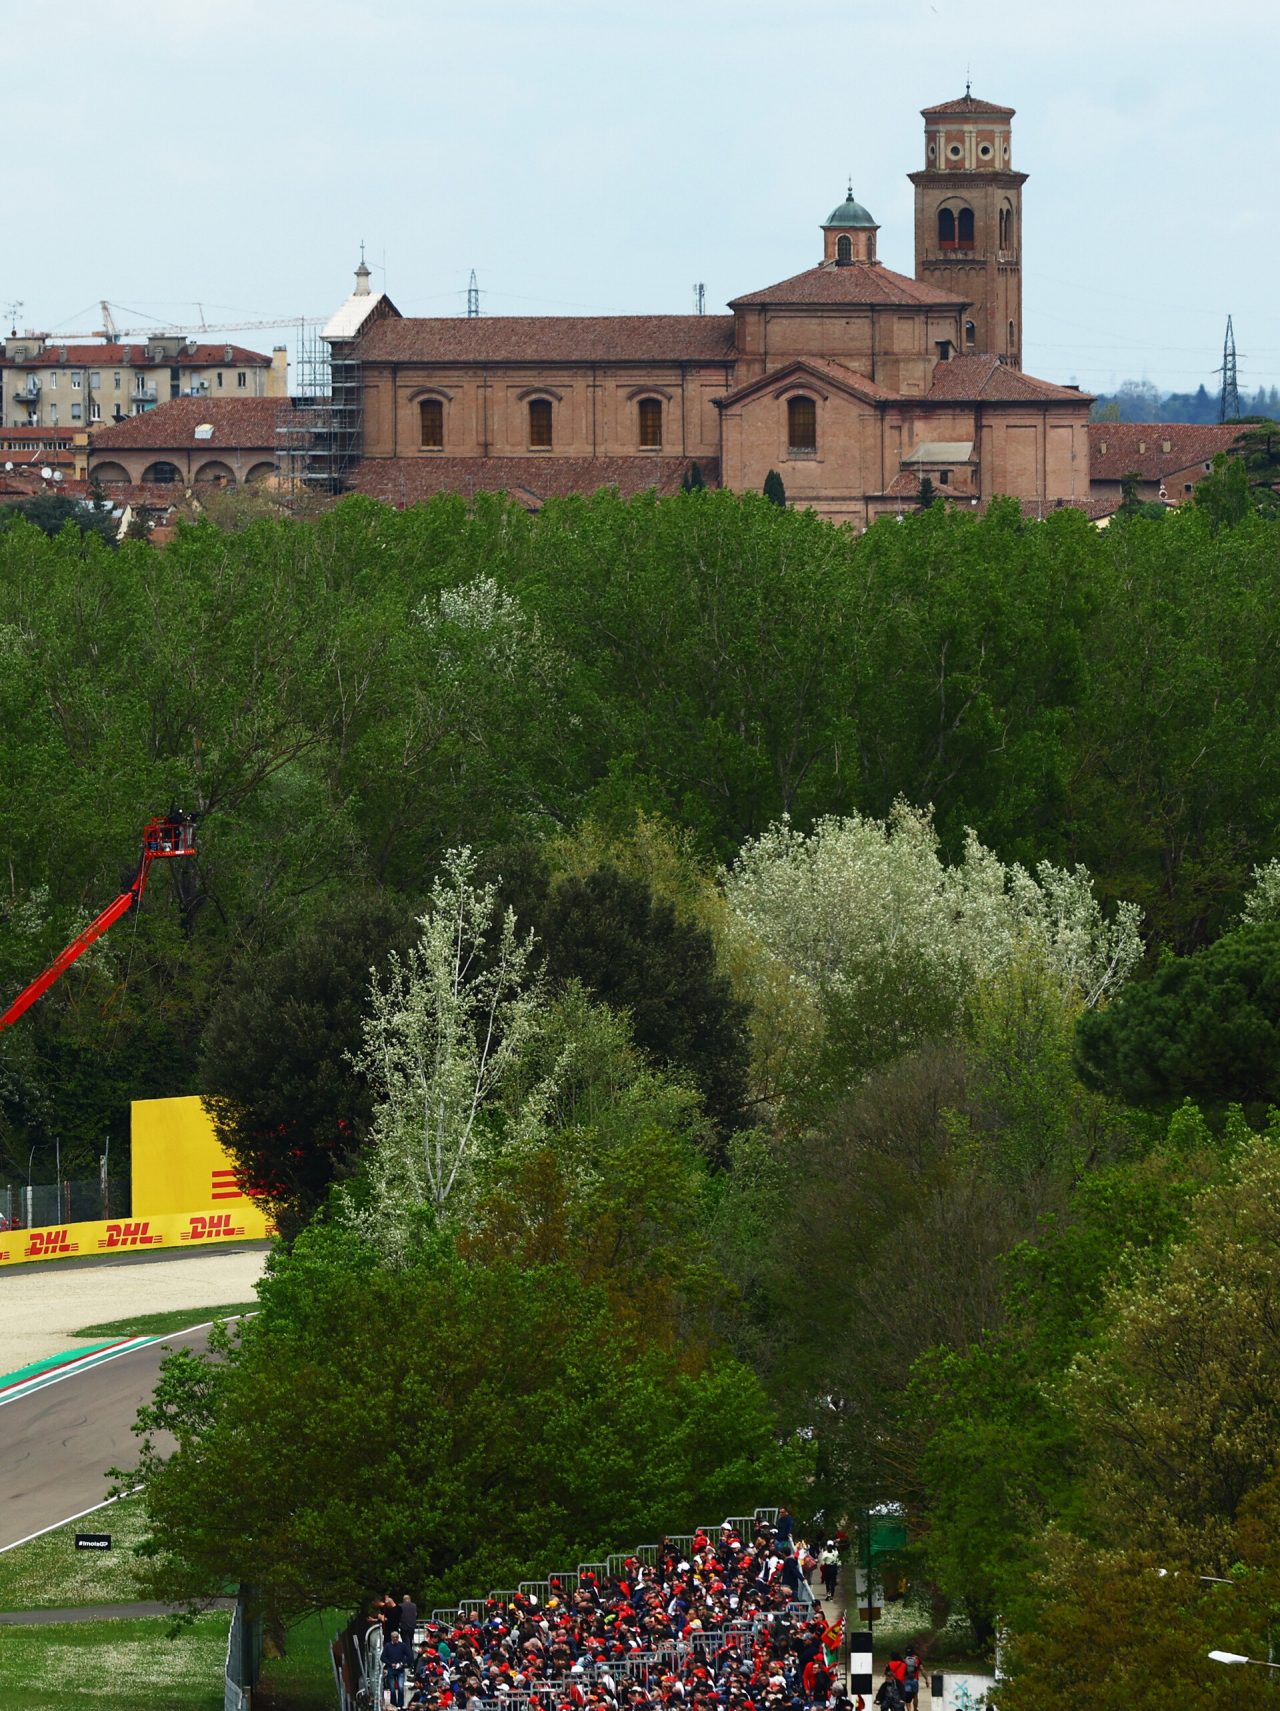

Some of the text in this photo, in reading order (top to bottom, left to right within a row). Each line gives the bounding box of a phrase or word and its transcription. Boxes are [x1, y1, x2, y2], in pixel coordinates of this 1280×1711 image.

[106, 1223, 154, 1247] DHL
[190, 1215, 236, 1239] DHL
[27, 1230, 71, 1256] DHL
